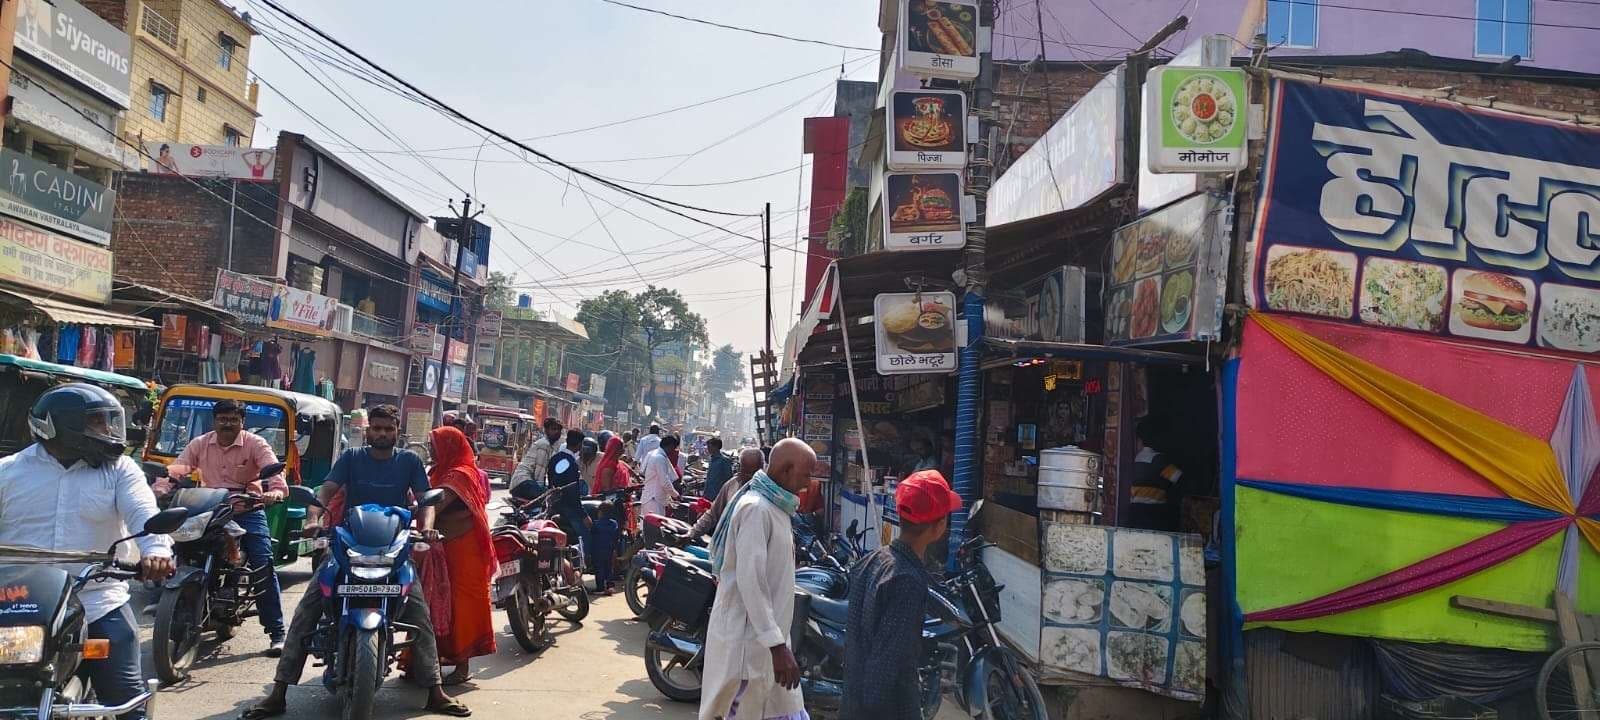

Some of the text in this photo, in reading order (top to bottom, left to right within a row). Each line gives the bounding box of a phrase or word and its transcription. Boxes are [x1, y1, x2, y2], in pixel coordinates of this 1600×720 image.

[56, 12, 129, 74] Siyarams
[930, 54, 954, 69] डोसा
[917, 151, 942, 162] पिज्जा
[1178, 149, 1230, 162] मोमोज
[33, 170, 104, 213] CADINI
[53, 202, 80, 215] ITALY
[7, 202, 80, 232] AWARAN VASTRALAYA
[888, 354, 916, 366] छोले
